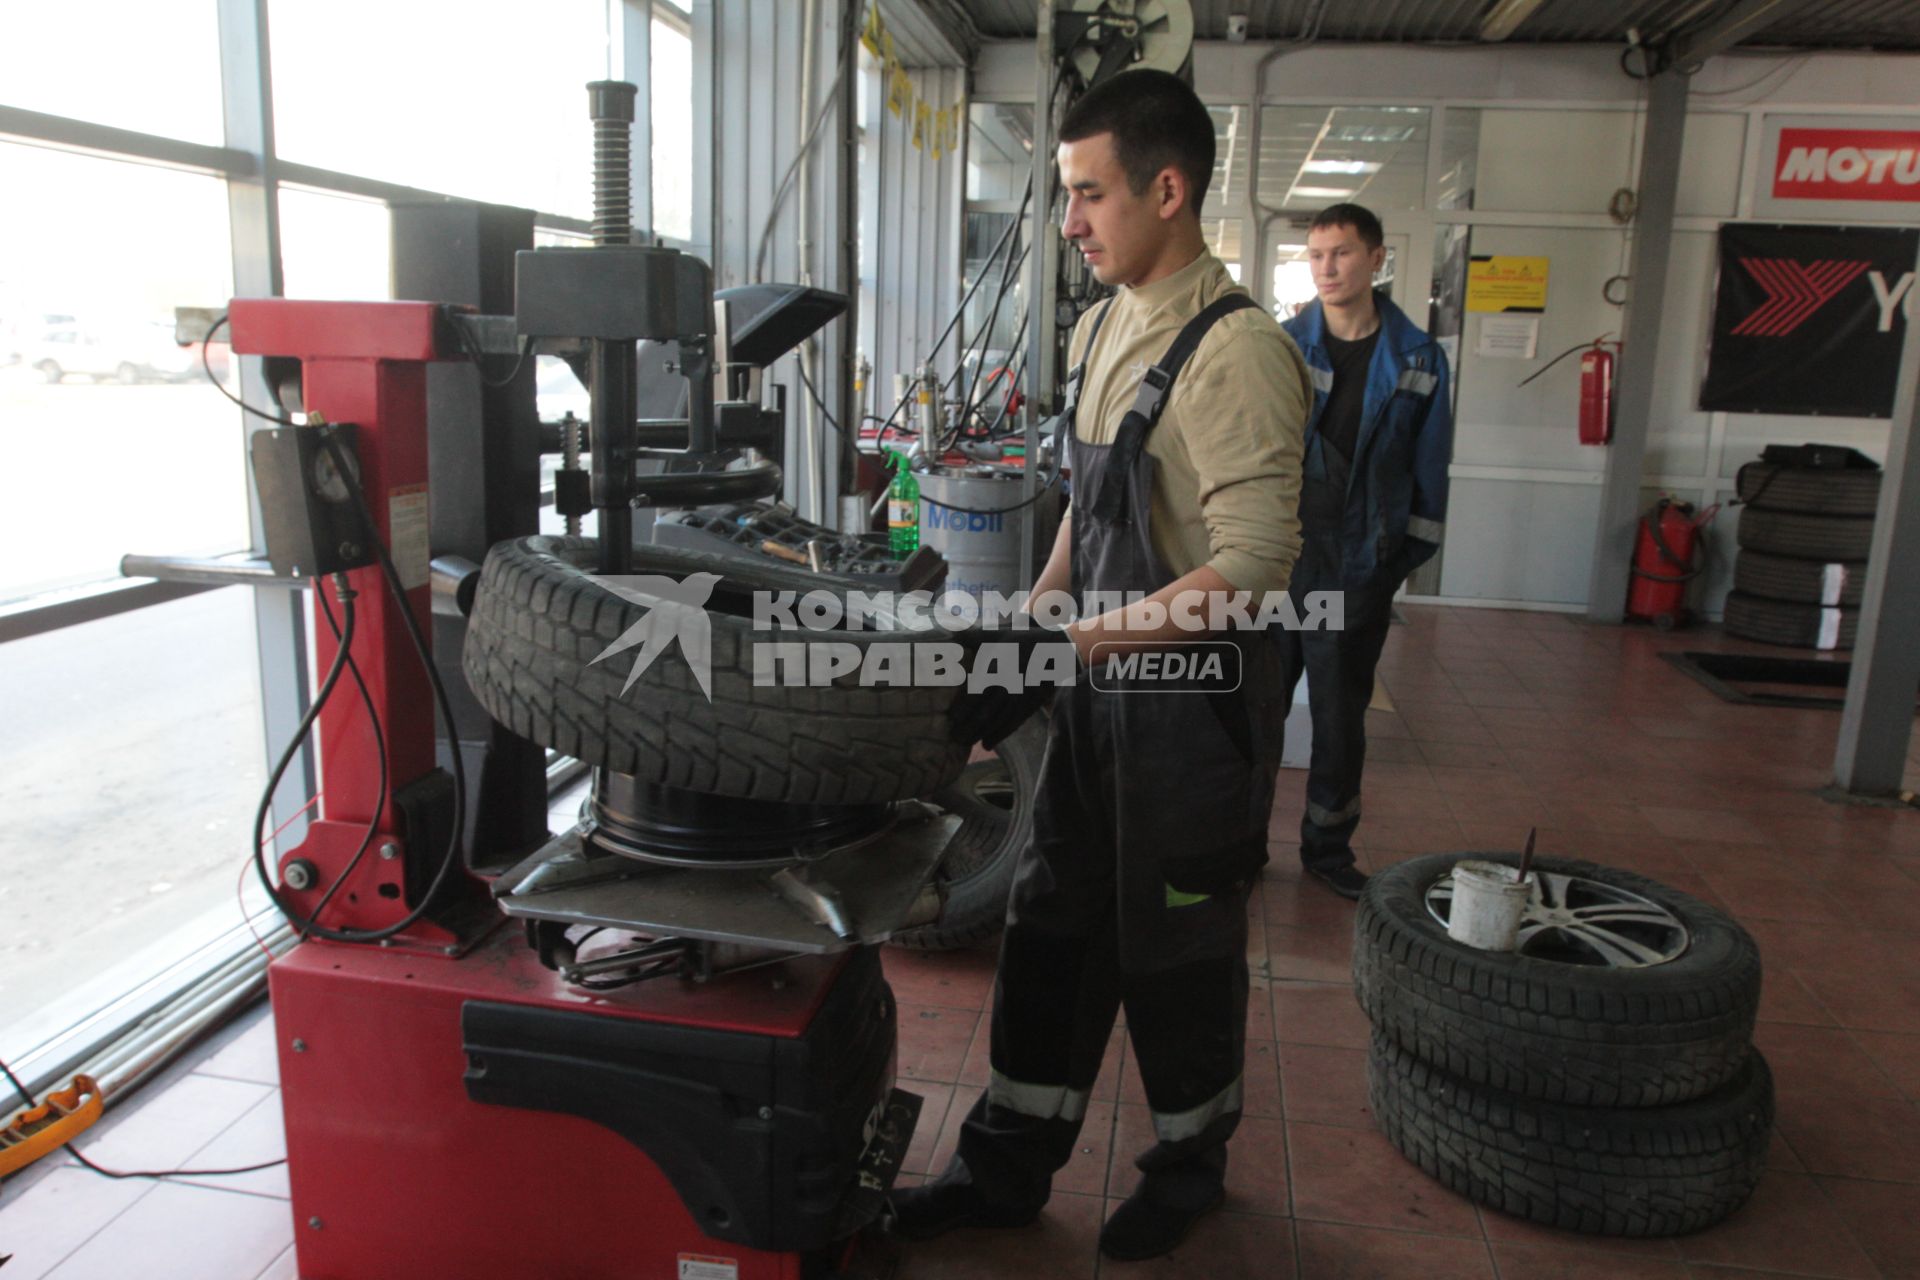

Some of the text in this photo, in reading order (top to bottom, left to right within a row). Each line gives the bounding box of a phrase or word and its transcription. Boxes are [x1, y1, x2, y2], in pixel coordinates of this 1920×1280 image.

[1779, 147, 1920, 185] MOTU
[1868, 271, 1916, 332] Y
[928, 503, 1004, 532] Mobil
